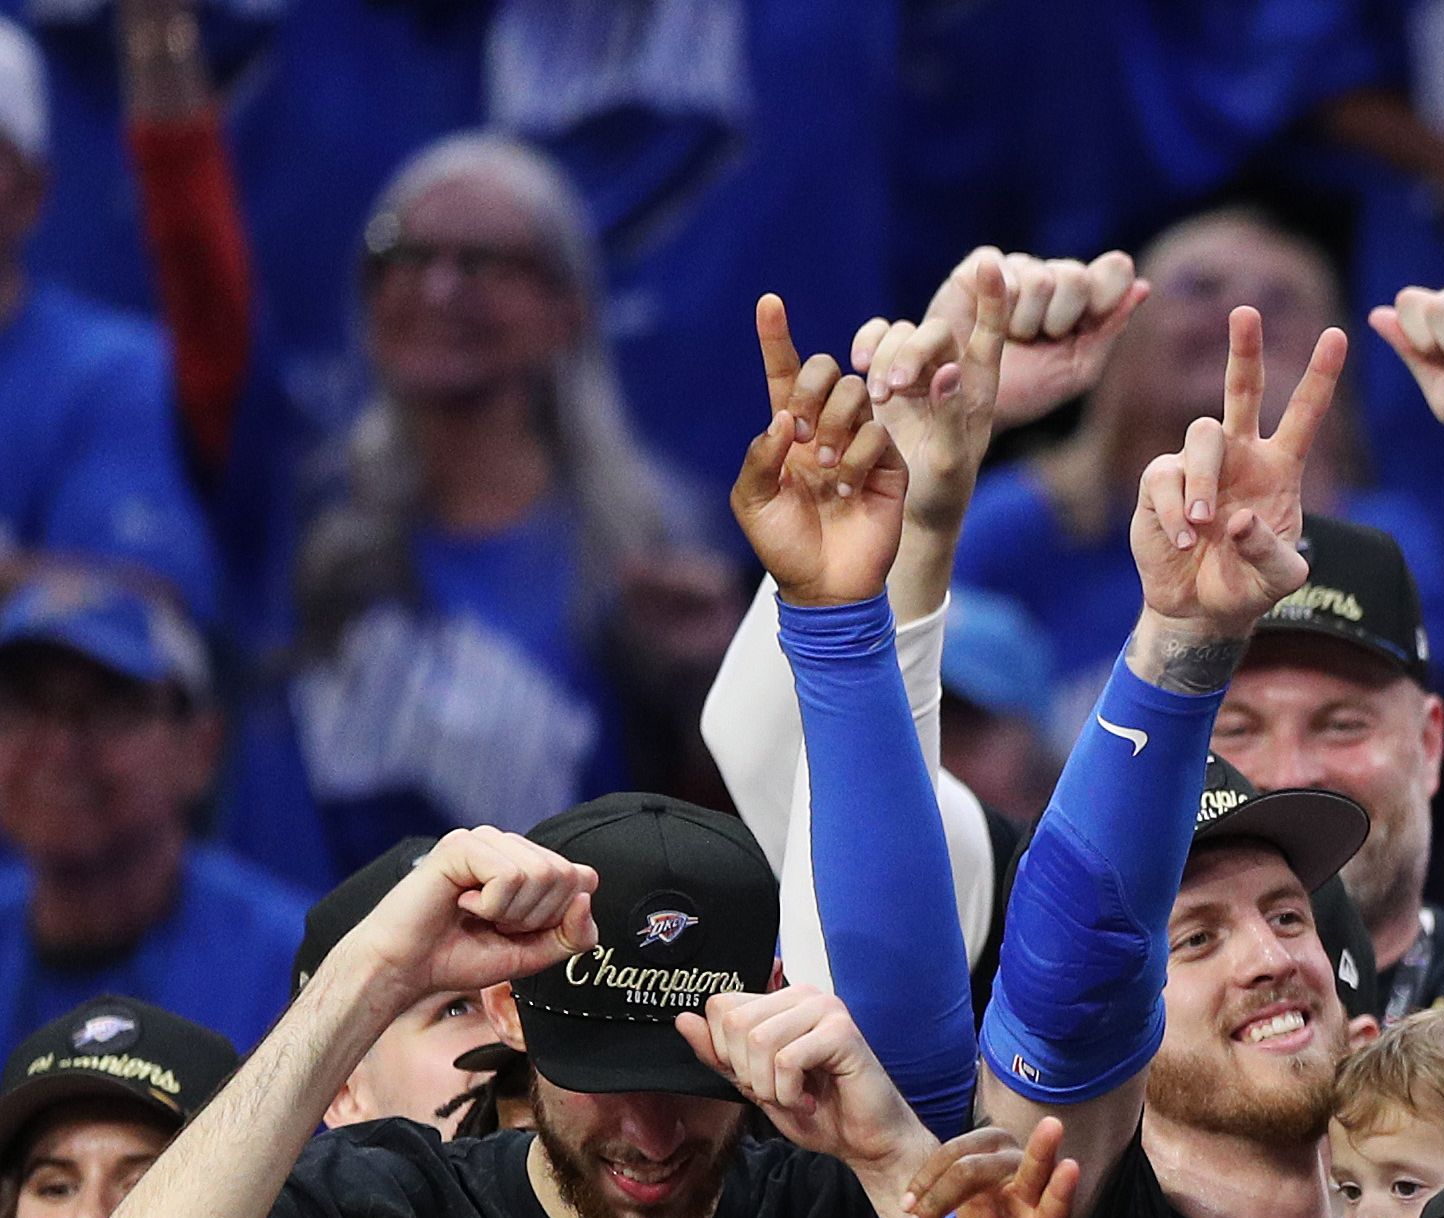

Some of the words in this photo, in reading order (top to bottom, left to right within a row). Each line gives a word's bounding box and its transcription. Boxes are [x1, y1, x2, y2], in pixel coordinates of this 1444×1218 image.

[566, 945, 744, 1007] Champions
[626, 990, 657, 1006] 2024
[670, 992, 700, 1007] 2025
